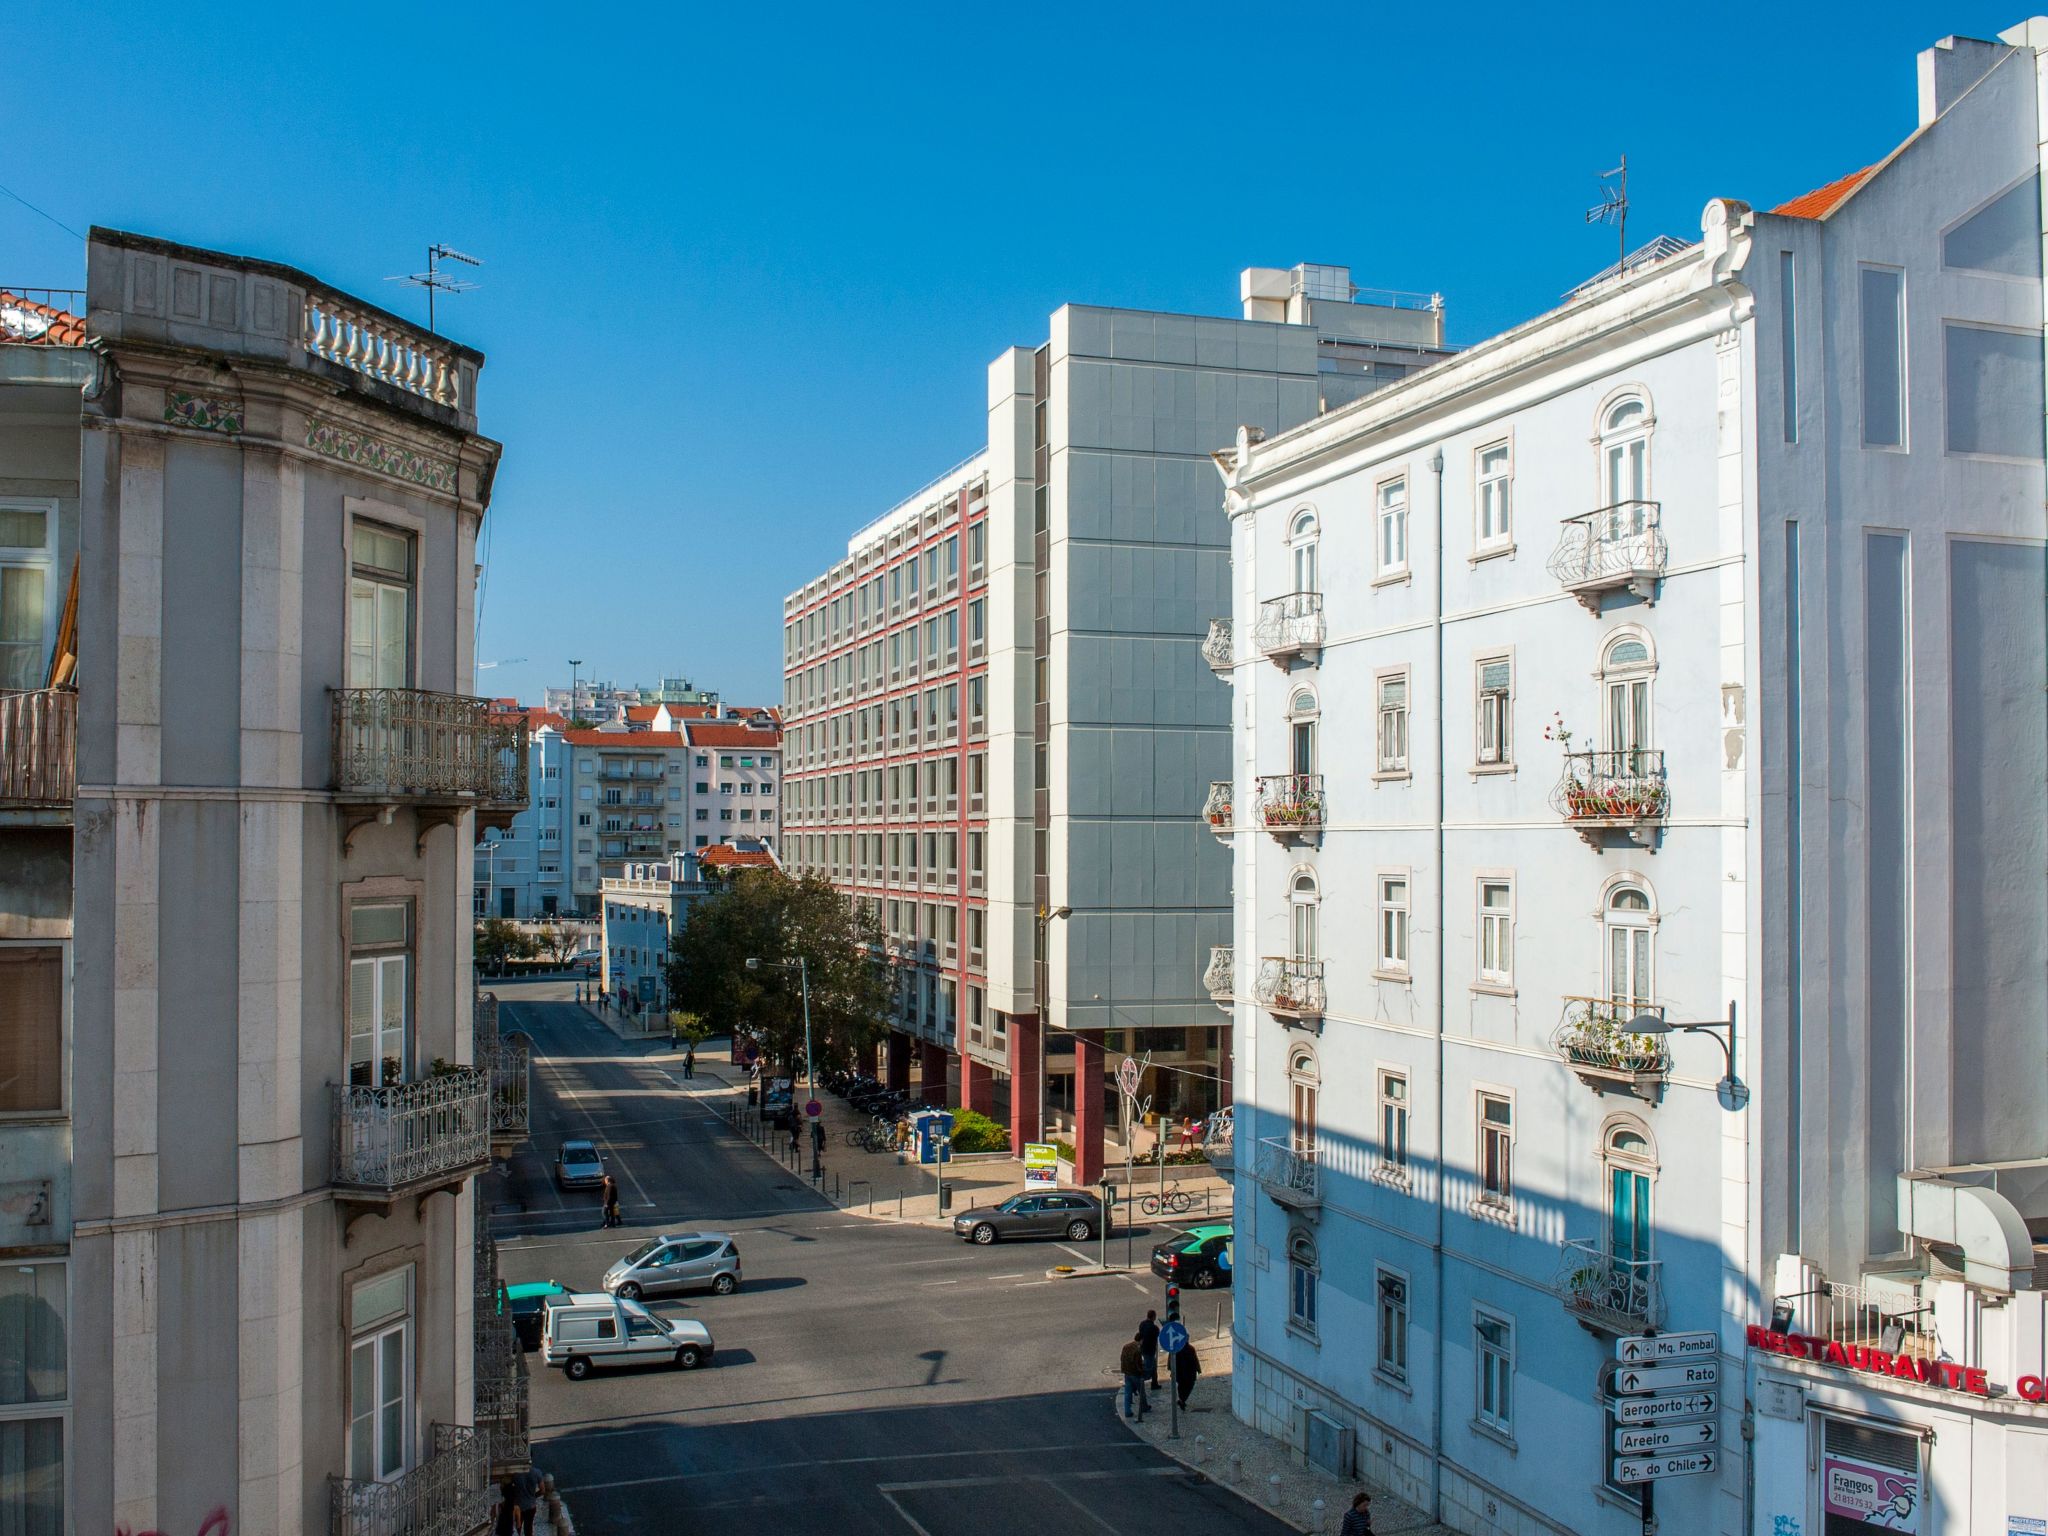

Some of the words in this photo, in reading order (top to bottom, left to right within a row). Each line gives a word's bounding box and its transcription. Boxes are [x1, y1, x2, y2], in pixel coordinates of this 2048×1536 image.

[1658, 1343, 1676, 1354] Mq.
[1680, 1338, 1715, 1352] Pombal
[1747, 1324, 1989, 1394] RESTAURANTE
[2017, 1374, 2048, 1402] C
[1686, 1368, 1715, 1382] Rato
[1624, 1400, 1682, 1416] aeroporto
[1624, 1433, 1669, 1448] Areeiro
[1623, 1466, 1639, 1479] Pç.
[1647, 1463, 1660, 1475] do
[1667, 1459, 1696, 1472] Chile
[1833, 1473, 1874, 1494] Frangos
